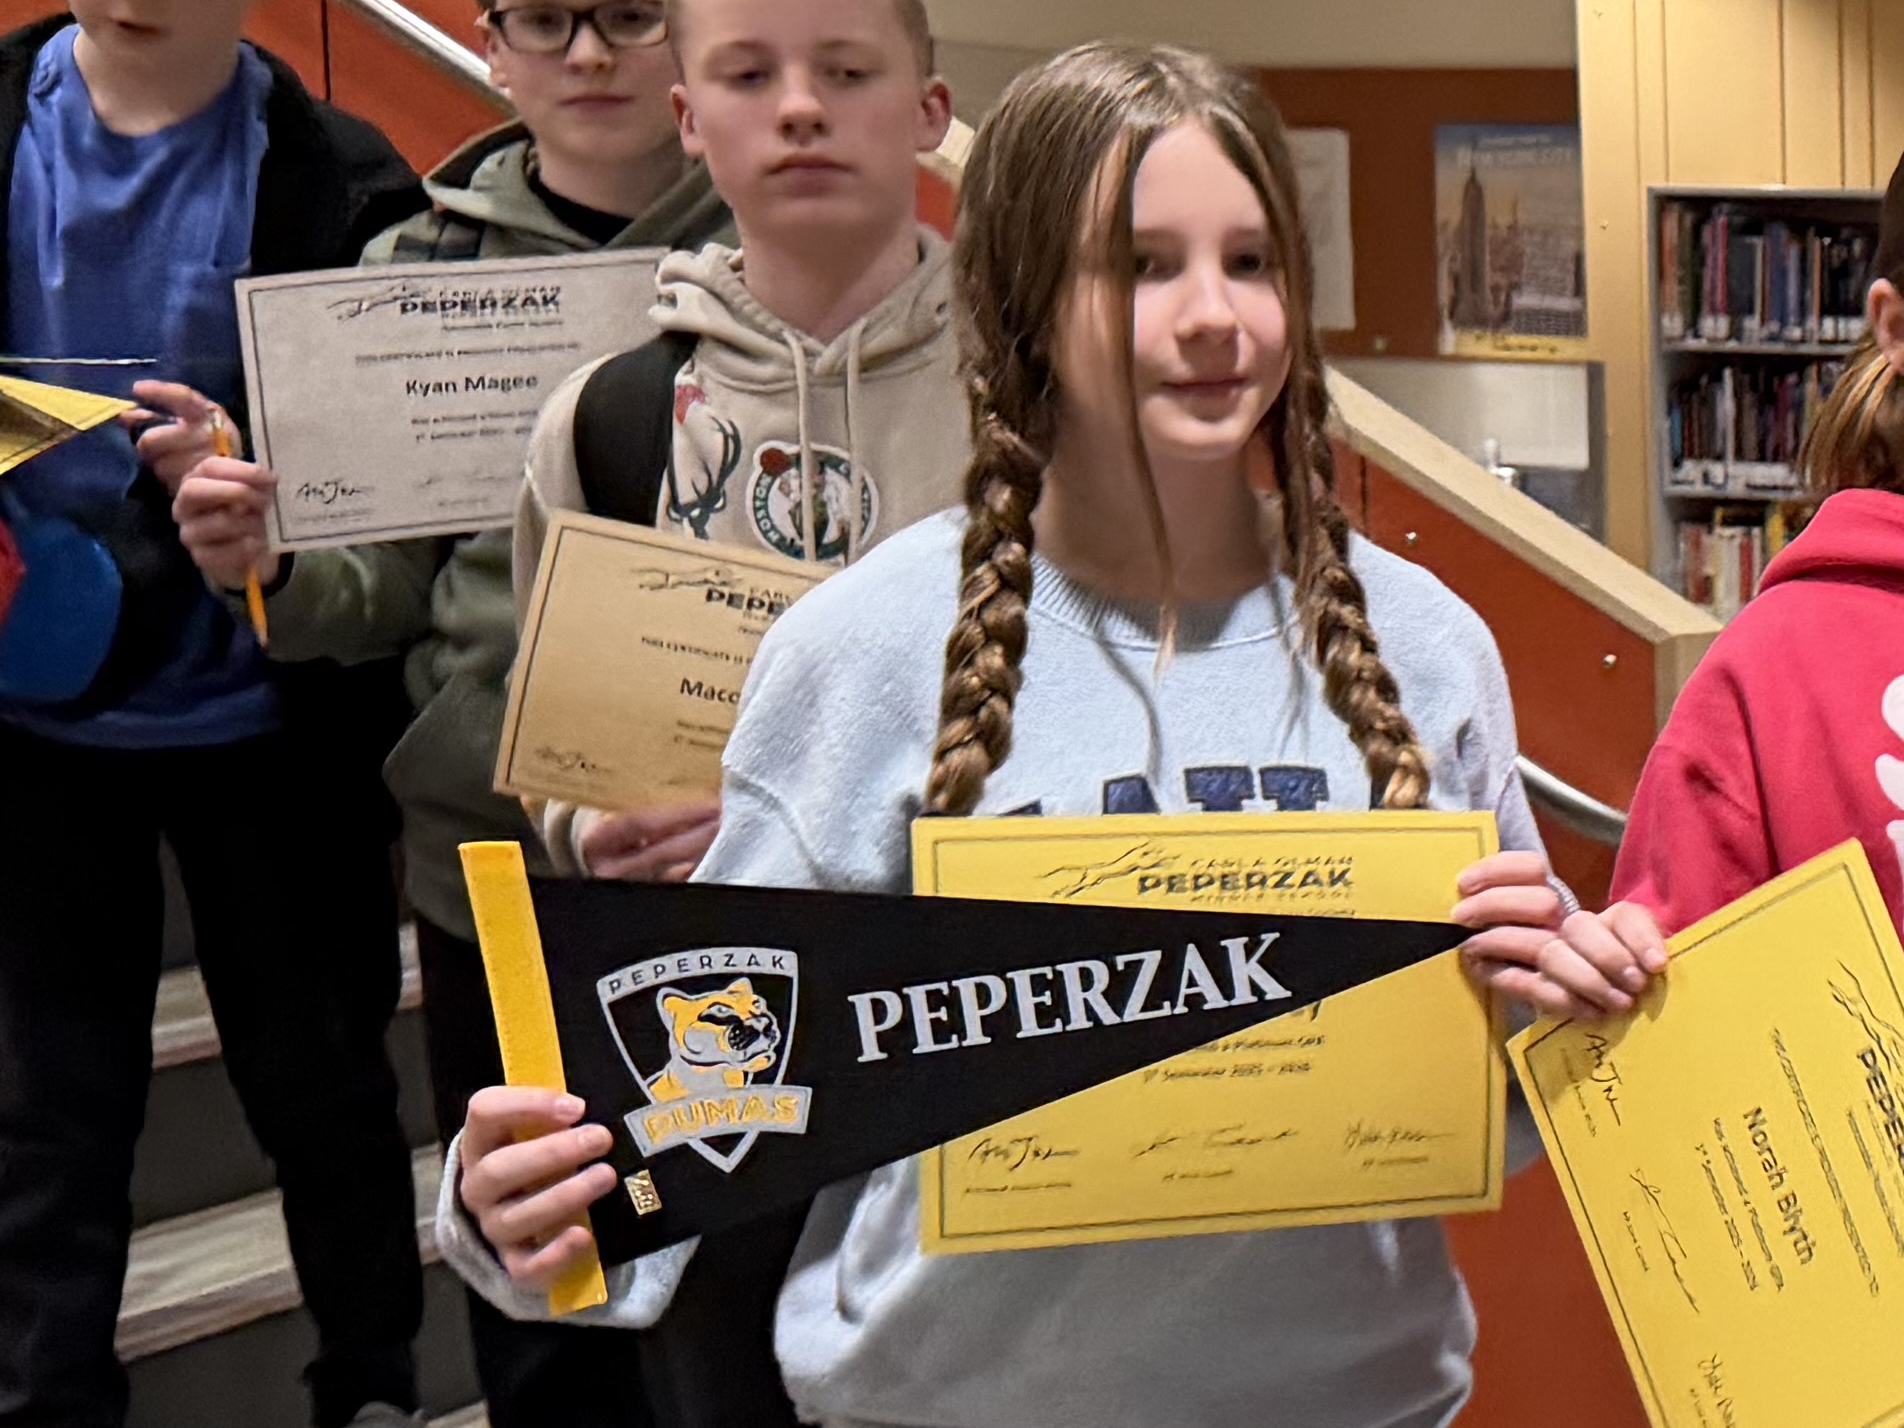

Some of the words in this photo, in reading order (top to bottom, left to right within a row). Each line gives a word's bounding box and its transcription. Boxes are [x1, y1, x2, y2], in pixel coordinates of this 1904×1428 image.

[406, 378, 458, 399] Kyan
[464, 374, 539, 395] Magee
[706, 587, 786, 616] PEPE
[1138, 868, 1354, 896] PEPERZAK
[608, 953, 785, 995] PEPERZAK
[848, 932, 1292, 1063] PEPERZAK
[644, 1095, 798, 1145] PUMAS
[1742, 1106, 1789, 1189] Norah
[1777, 1191, 1816, 1266] Blyth
